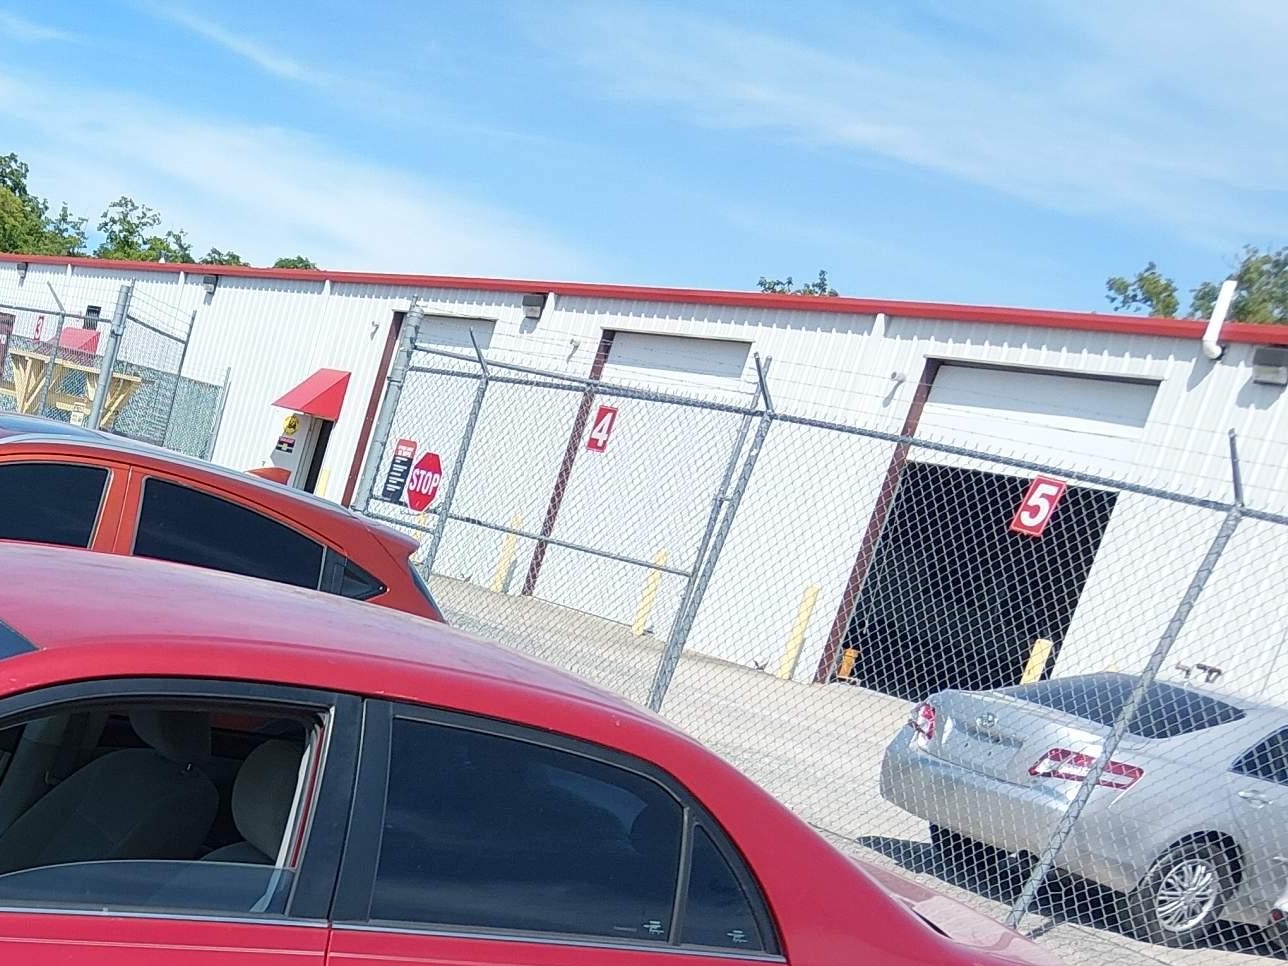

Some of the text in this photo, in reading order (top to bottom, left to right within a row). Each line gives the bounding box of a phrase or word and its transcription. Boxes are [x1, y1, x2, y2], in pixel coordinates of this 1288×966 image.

[591, 412, 614, 447] 4
[409, 468, 440, 496] STOP
[1020, 483, 1060, 527] 5
